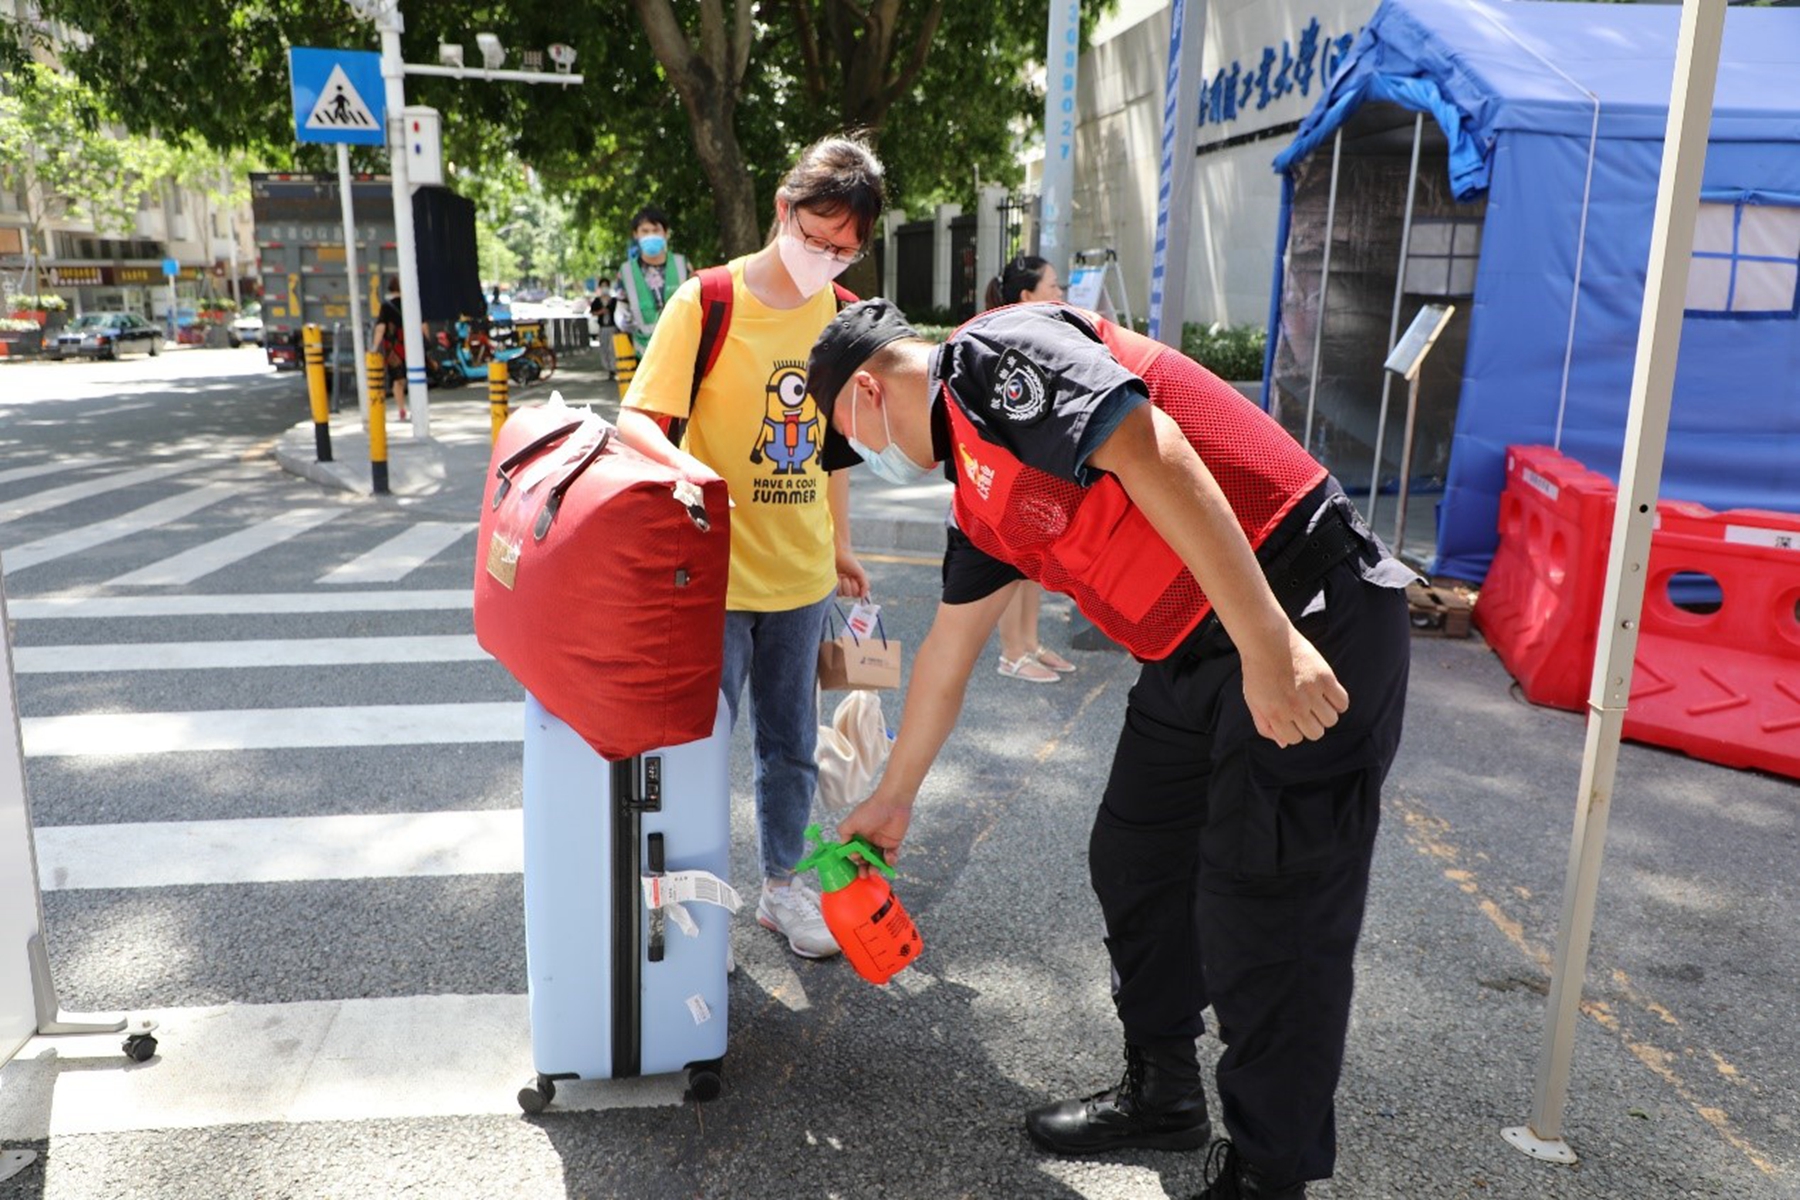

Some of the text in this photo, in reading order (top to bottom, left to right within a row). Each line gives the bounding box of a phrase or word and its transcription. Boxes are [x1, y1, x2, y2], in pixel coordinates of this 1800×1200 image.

[753, 478, 783, 489] HAVE
[786, 478, 793, 489] A
[752, 489, 817, 504] SUMMER
